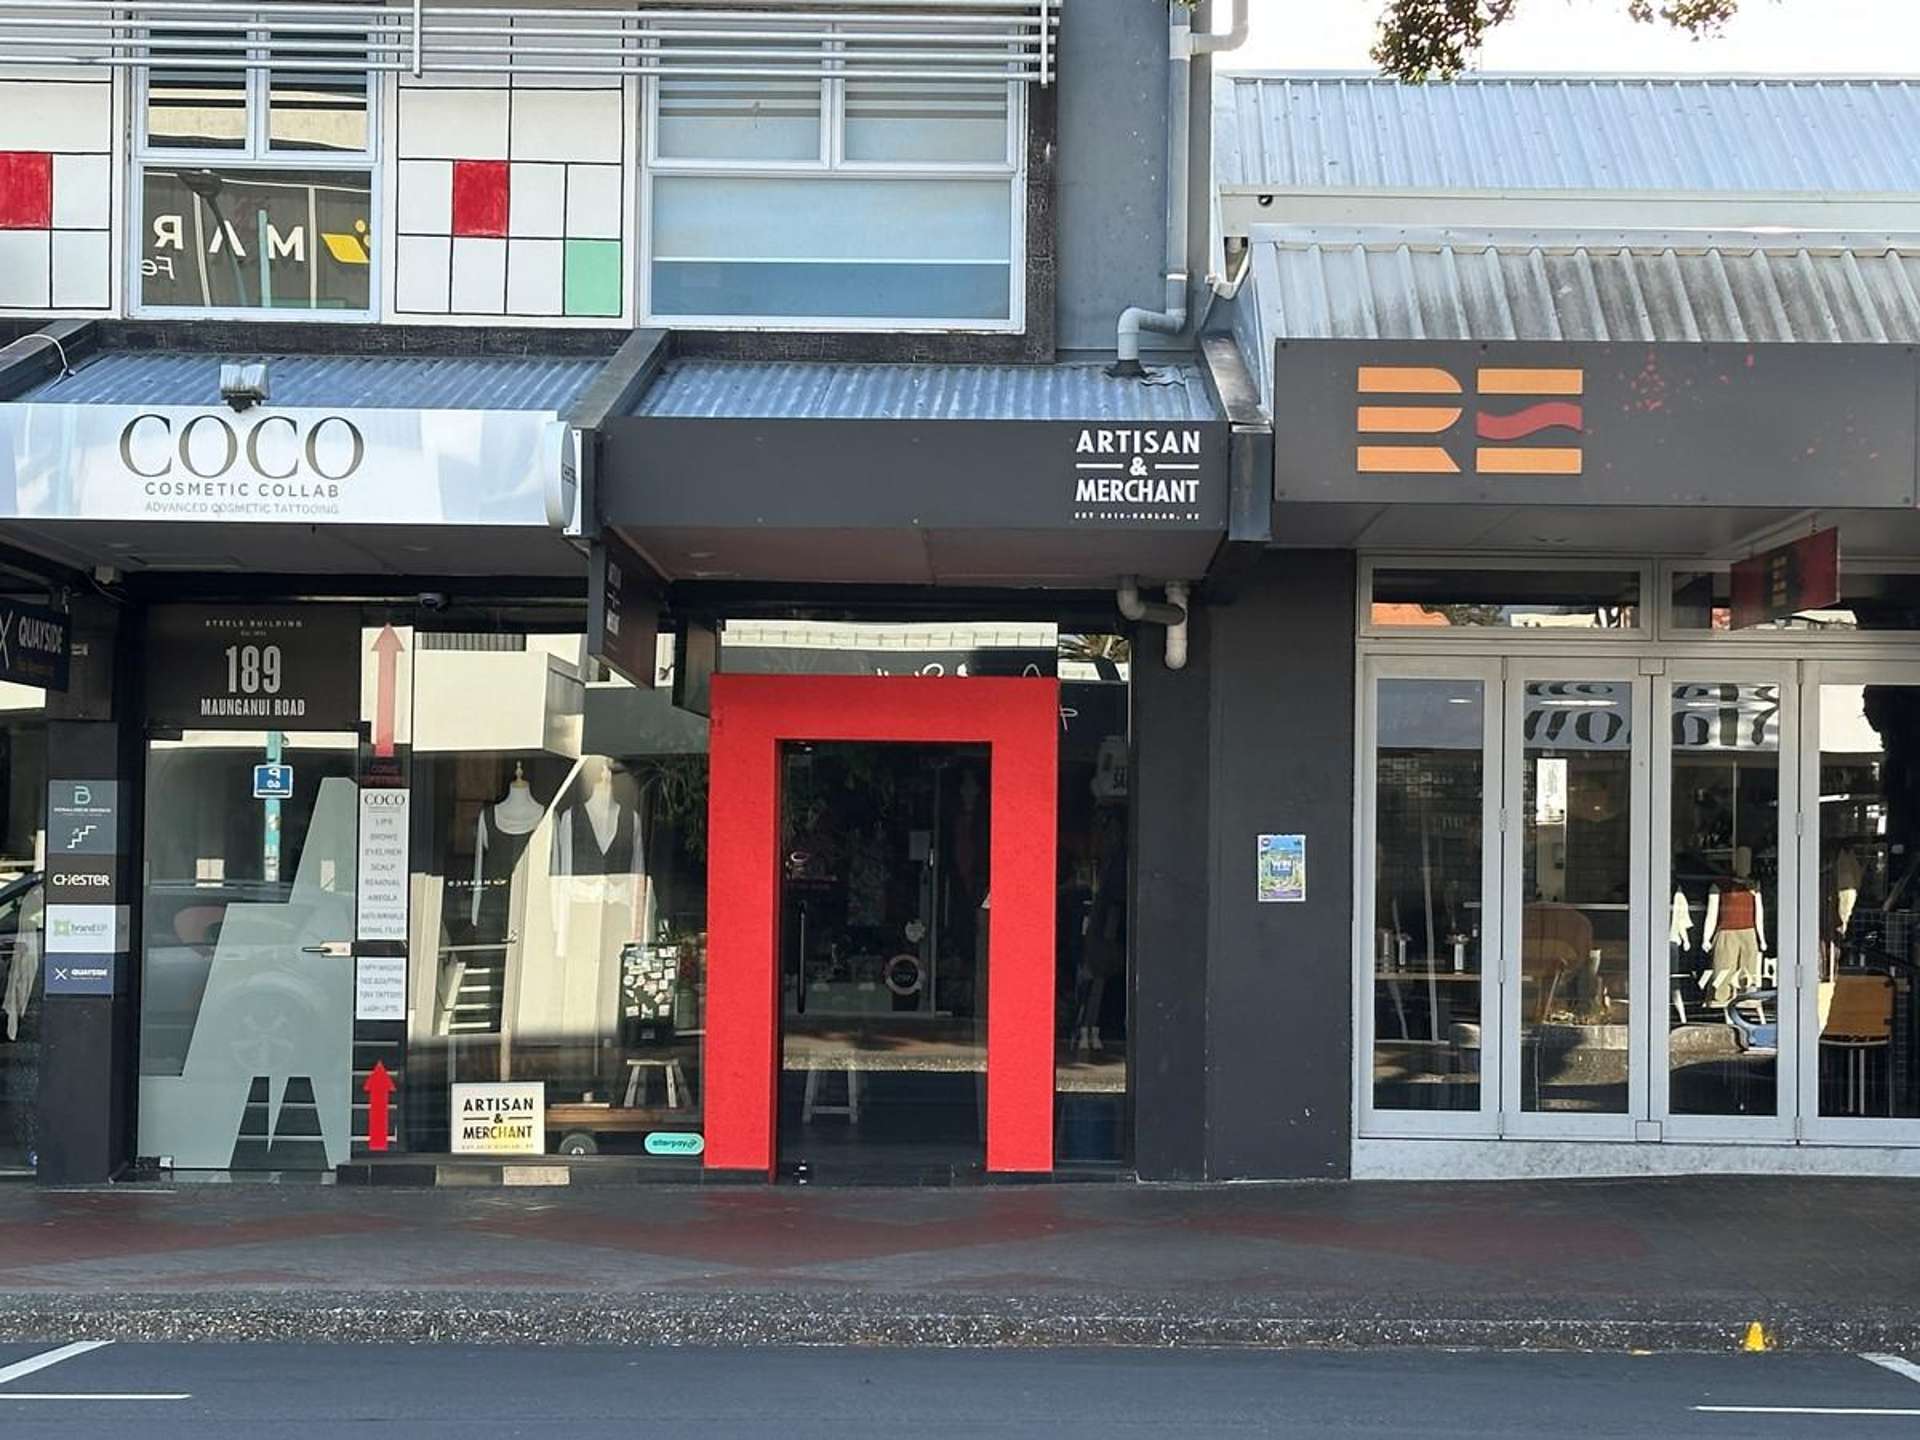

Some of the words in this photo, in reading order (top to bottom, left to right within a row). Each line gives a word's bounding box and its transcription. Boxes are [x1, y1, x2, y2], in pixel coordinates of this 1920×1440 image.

[119, 413, 364, 481] COCO
[1076, 430, 1200, 454] ARTISAN
[1129, 456, 1148, 476] &
[145, 482, 249, 497] COSMETIC
[258, 483, 339, 498] COLLAB
[1075, 479, 1200, 503] MERCHANT
[145, 501, 208, 513] ADVANCED
[211, 502, 271, 515] COSMETIC
[274, 503, 339, 515] TATTOOING
[225, 645, 281, 694] 189
[201, 698, 270, 717] MAUNGANUI
[274, 699, 305, 717] ROAD
[364, 793, 406, 806] COCO
[463, 1097, 534, 1112] ARTISAN
[493, 1113, 504, 1124] &
[462, 1125, 533, 1140] MERCHANT
